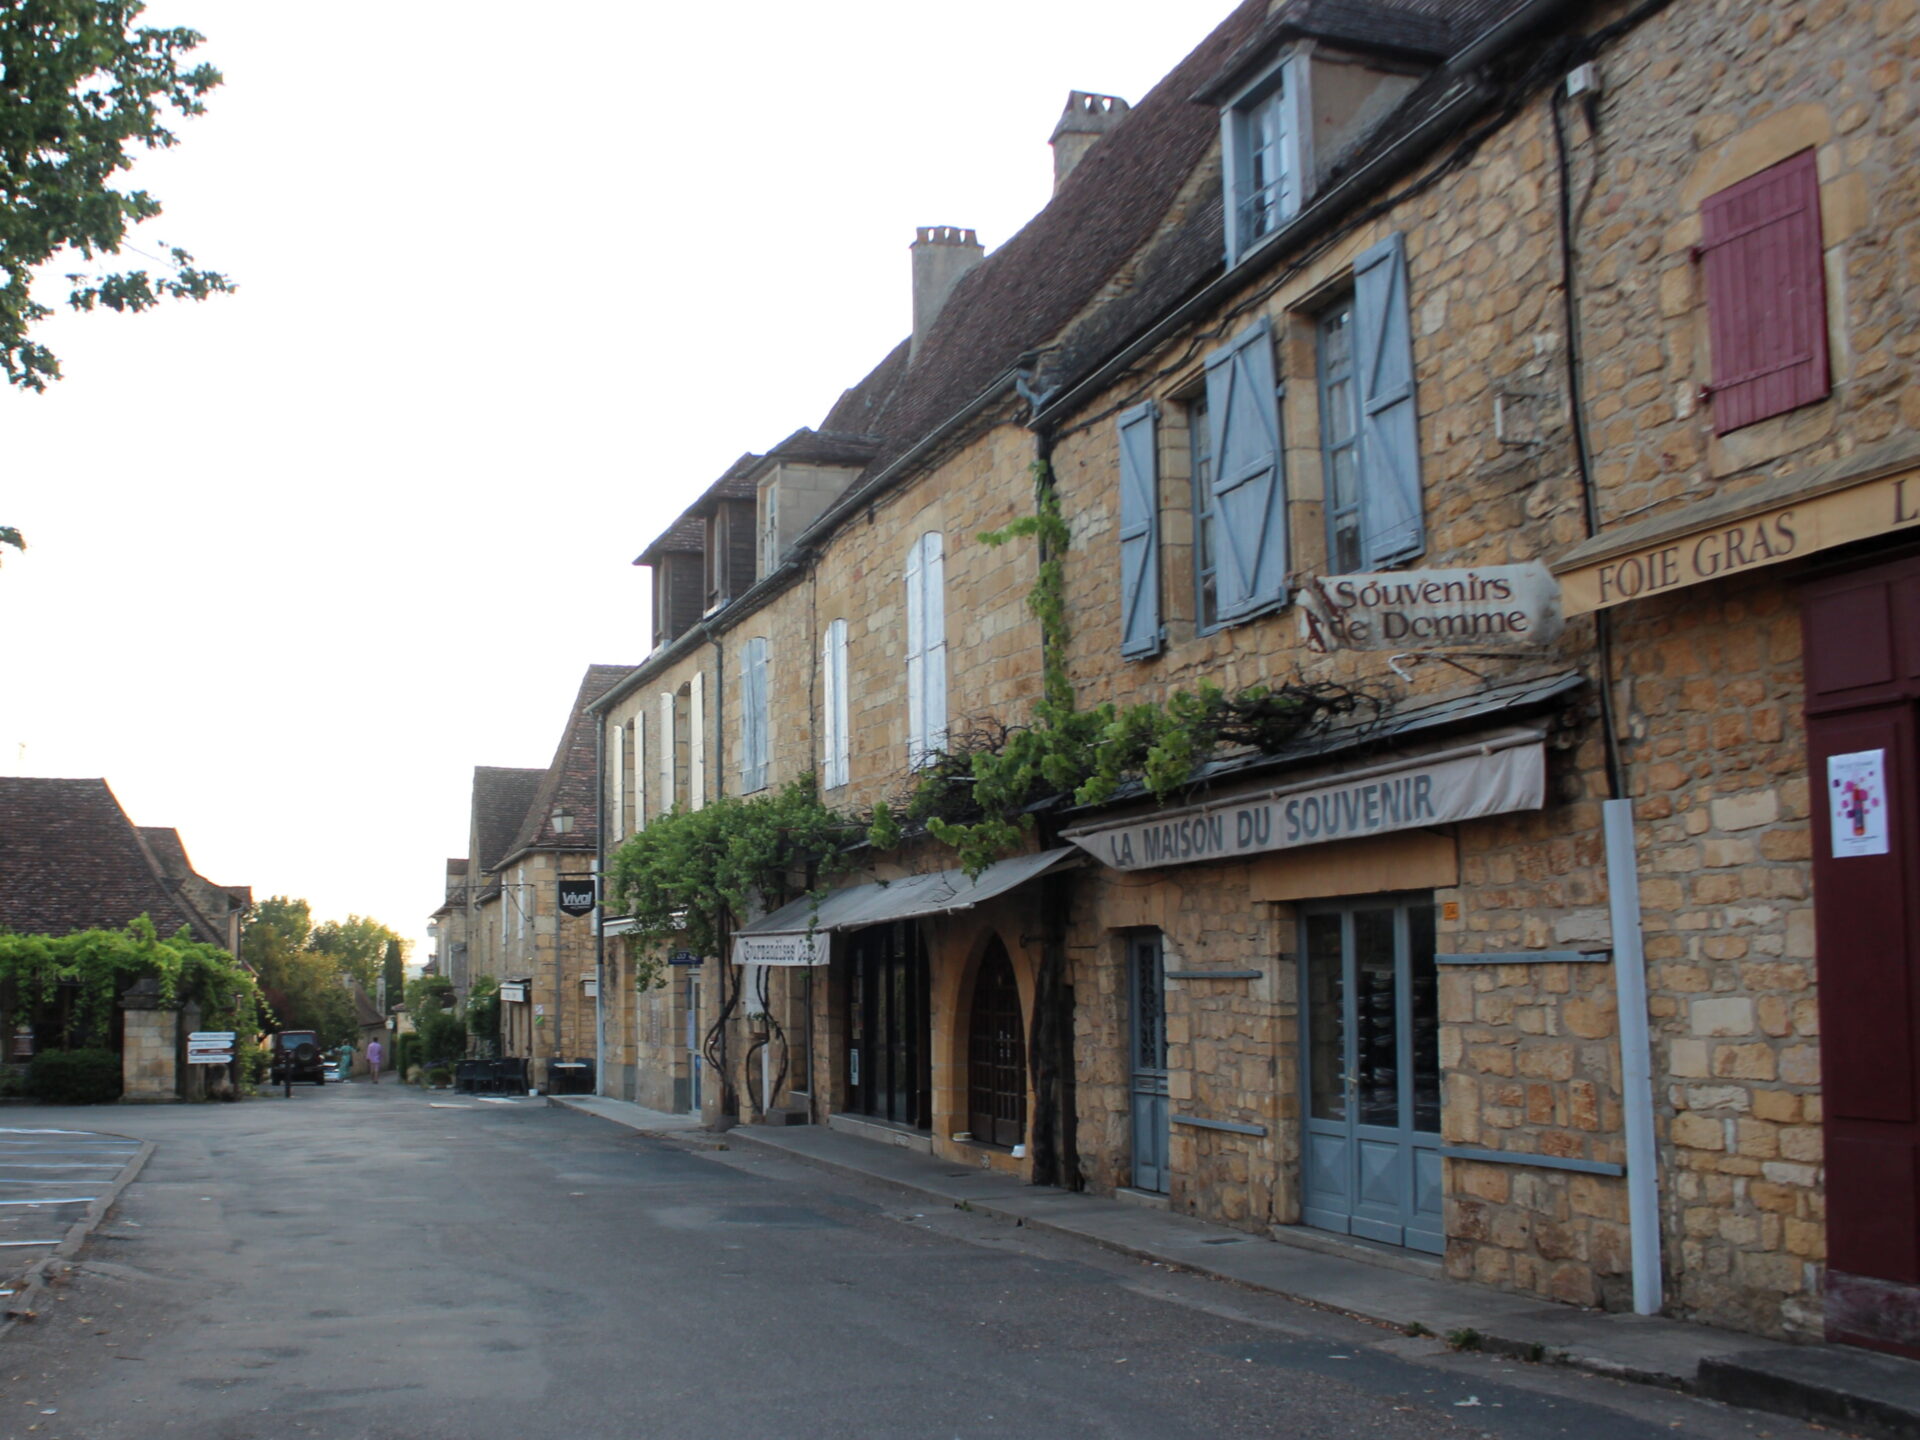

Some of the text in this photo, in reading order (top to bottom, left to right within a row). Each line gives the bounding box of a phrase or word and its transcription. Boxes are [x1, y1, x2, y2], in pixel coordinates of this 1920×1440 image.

[1596, 546, 1680, 604] FOIE
[1693, 511, 1797, 578] GRAS
[1336, 572, 1511, 609] Souvenirs
[1381, 609, 1528, 641] Domme
[1110, 773, 1436, 867] LA MAISON DU SOUVENIR
